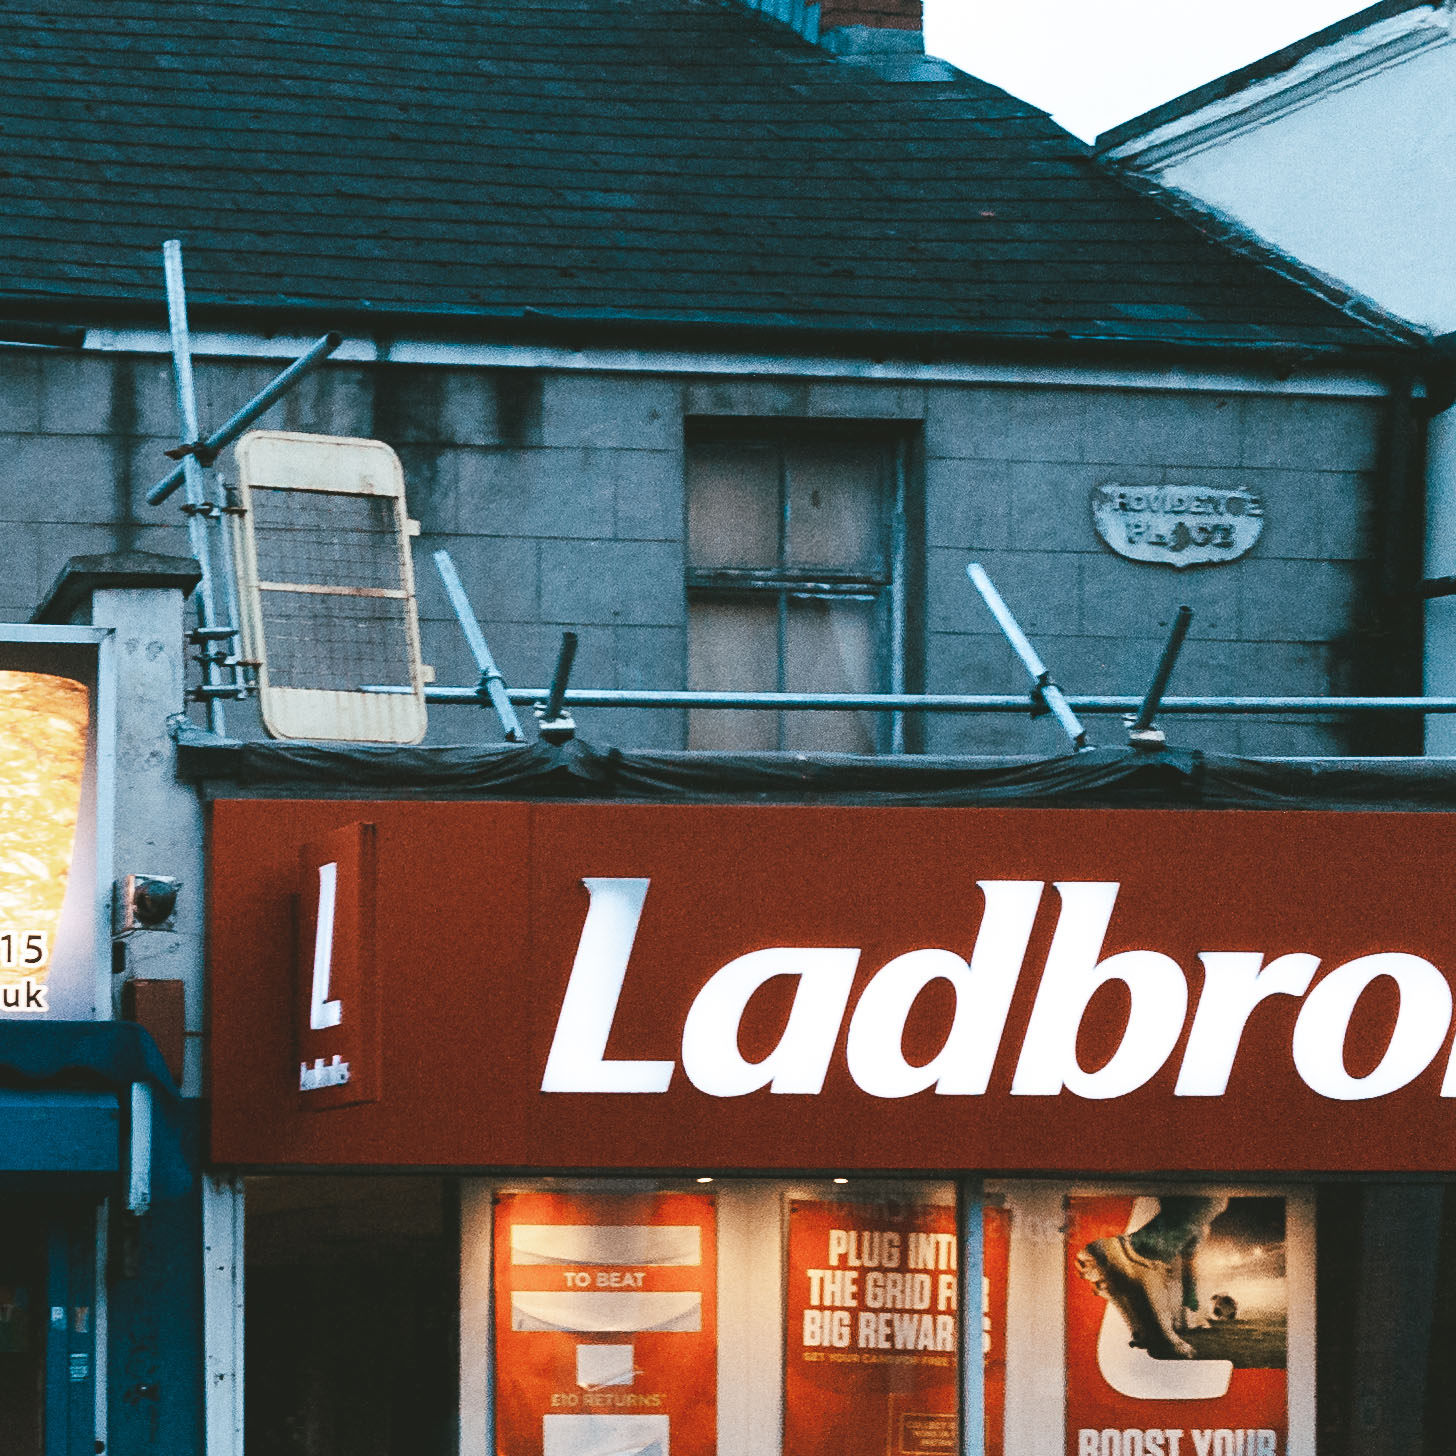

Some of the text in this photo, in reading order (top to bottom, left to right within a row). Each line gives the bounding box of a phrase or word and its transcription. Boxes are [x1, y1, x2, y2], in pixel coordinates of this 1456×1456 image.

[1125, 521, 1235, 550] PLCE
[540, 875, 1456, 1100] Ladbro
[829, 1229, 901, 1269] PLUG
[563, 1271, 646, 1288] TO BEAT
[806, 1268, 859, 1307] THE
[865, 1271, 933, 1311] GRID
[802, 1309, 992, 1354] BIG REWARS
